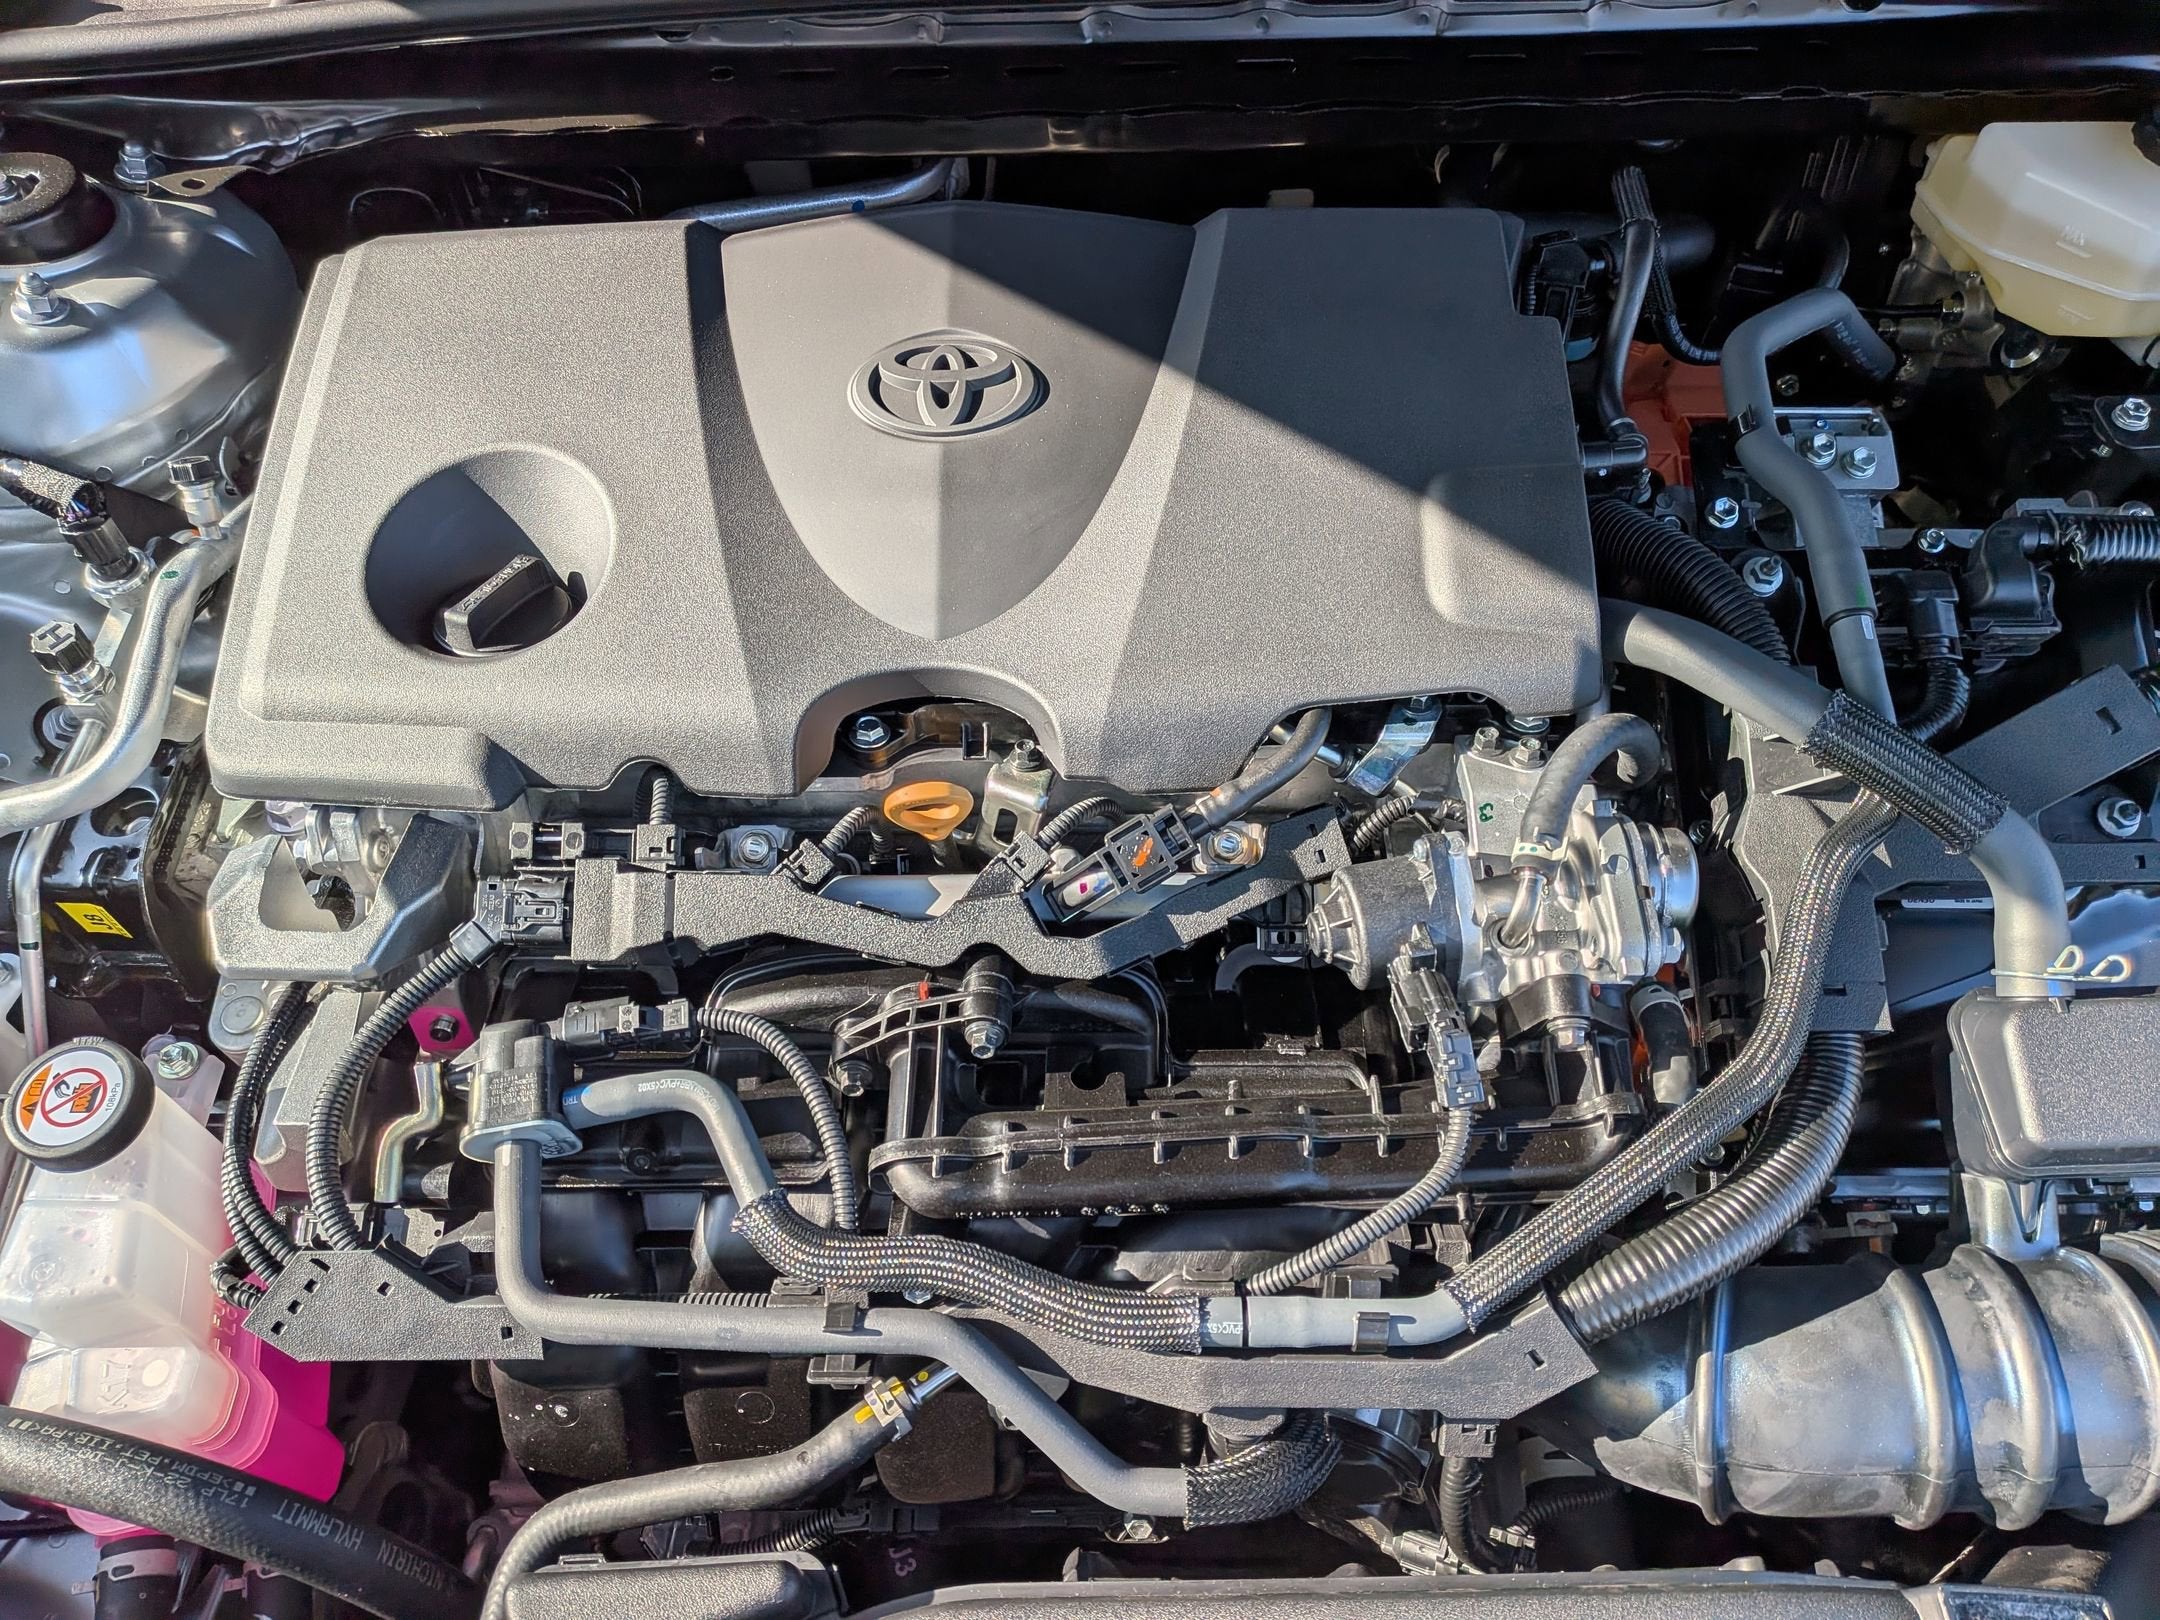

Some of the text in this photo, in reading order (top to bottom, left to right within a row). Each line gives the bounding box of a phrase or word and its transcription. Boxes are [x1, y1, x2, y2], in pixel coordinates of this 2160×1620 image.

[37, 623, 74, 651] H
[105, 1082, 121, 1113] 108kPa
[888, 1547, 917, 1577] J3
